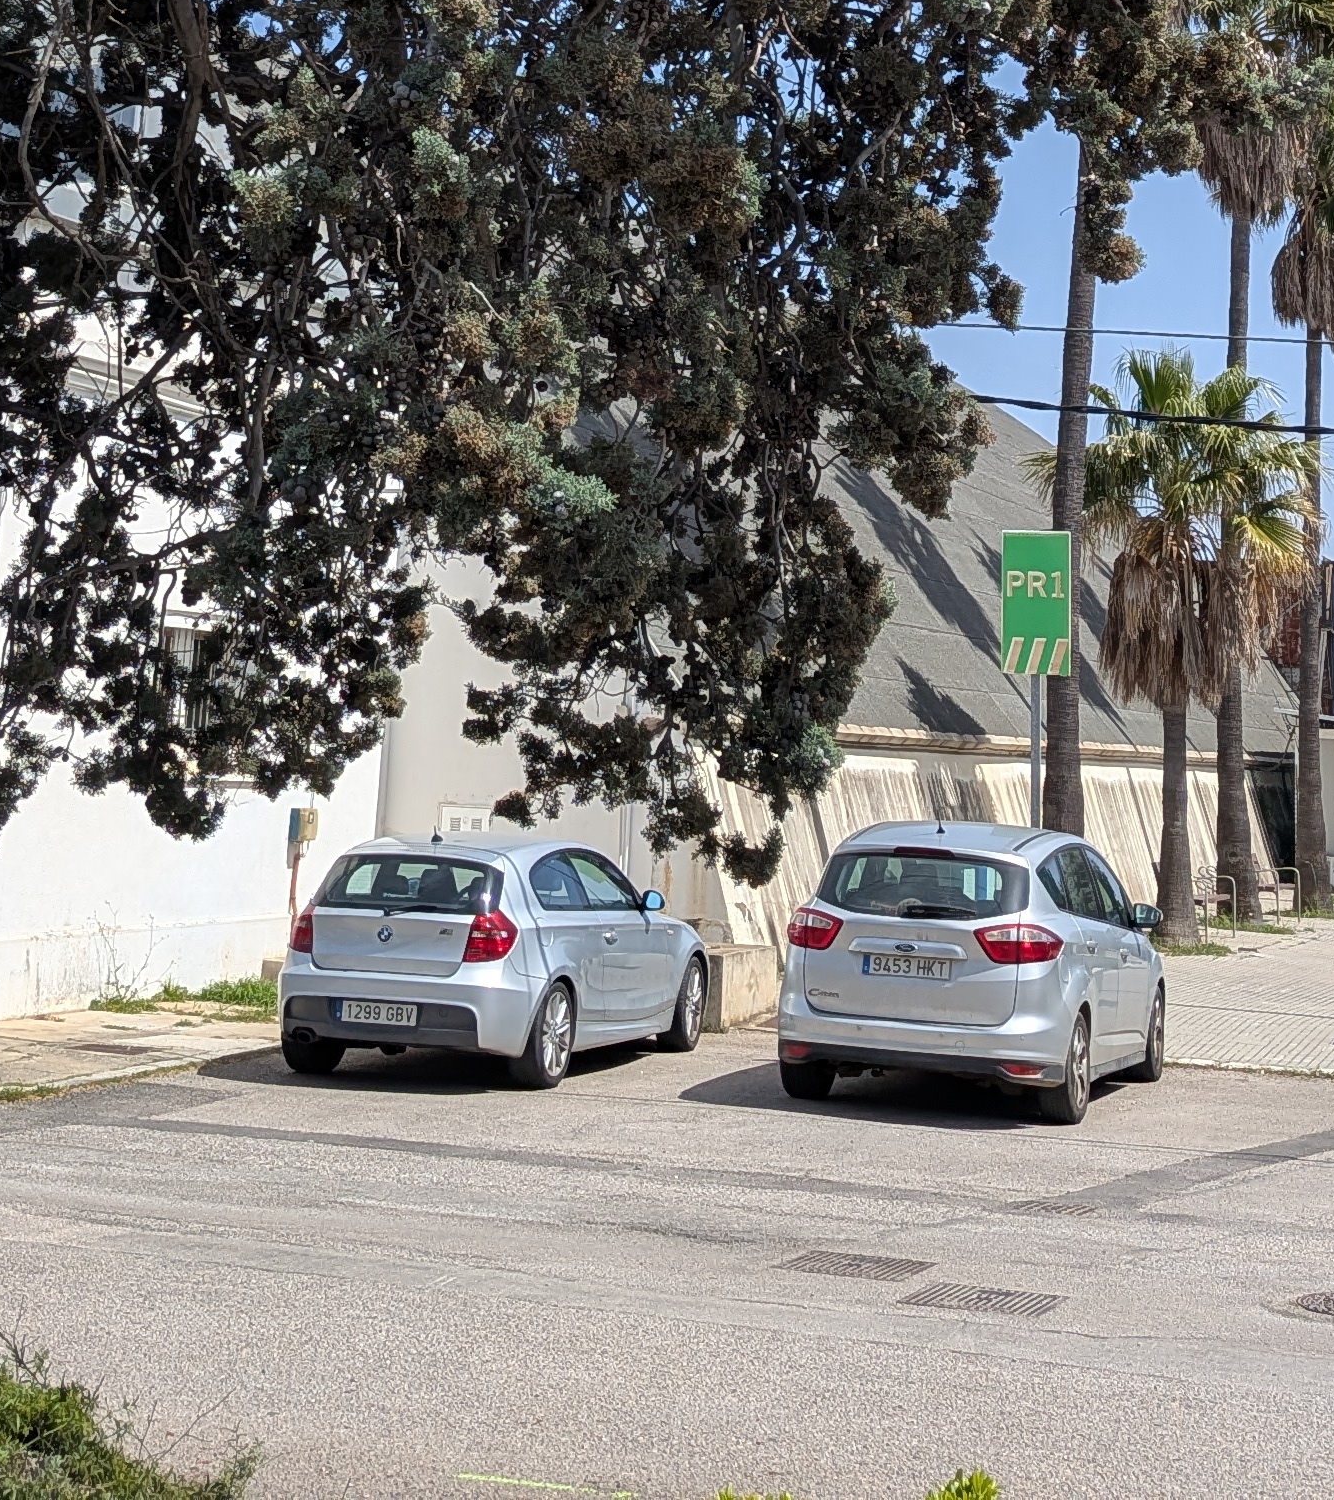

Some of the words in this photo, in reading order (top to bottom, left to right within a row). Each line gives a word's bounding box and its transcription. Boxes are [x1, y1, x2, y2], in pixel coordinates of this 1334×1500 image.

[1006, 570, 1065, 599] PR1
[872, 956, 912, 974] 9453
[916, 959, 947, 977] HKT
[347, 1003, 381, 1021] 1299
[385, 1006, 414, 1023] GBV
